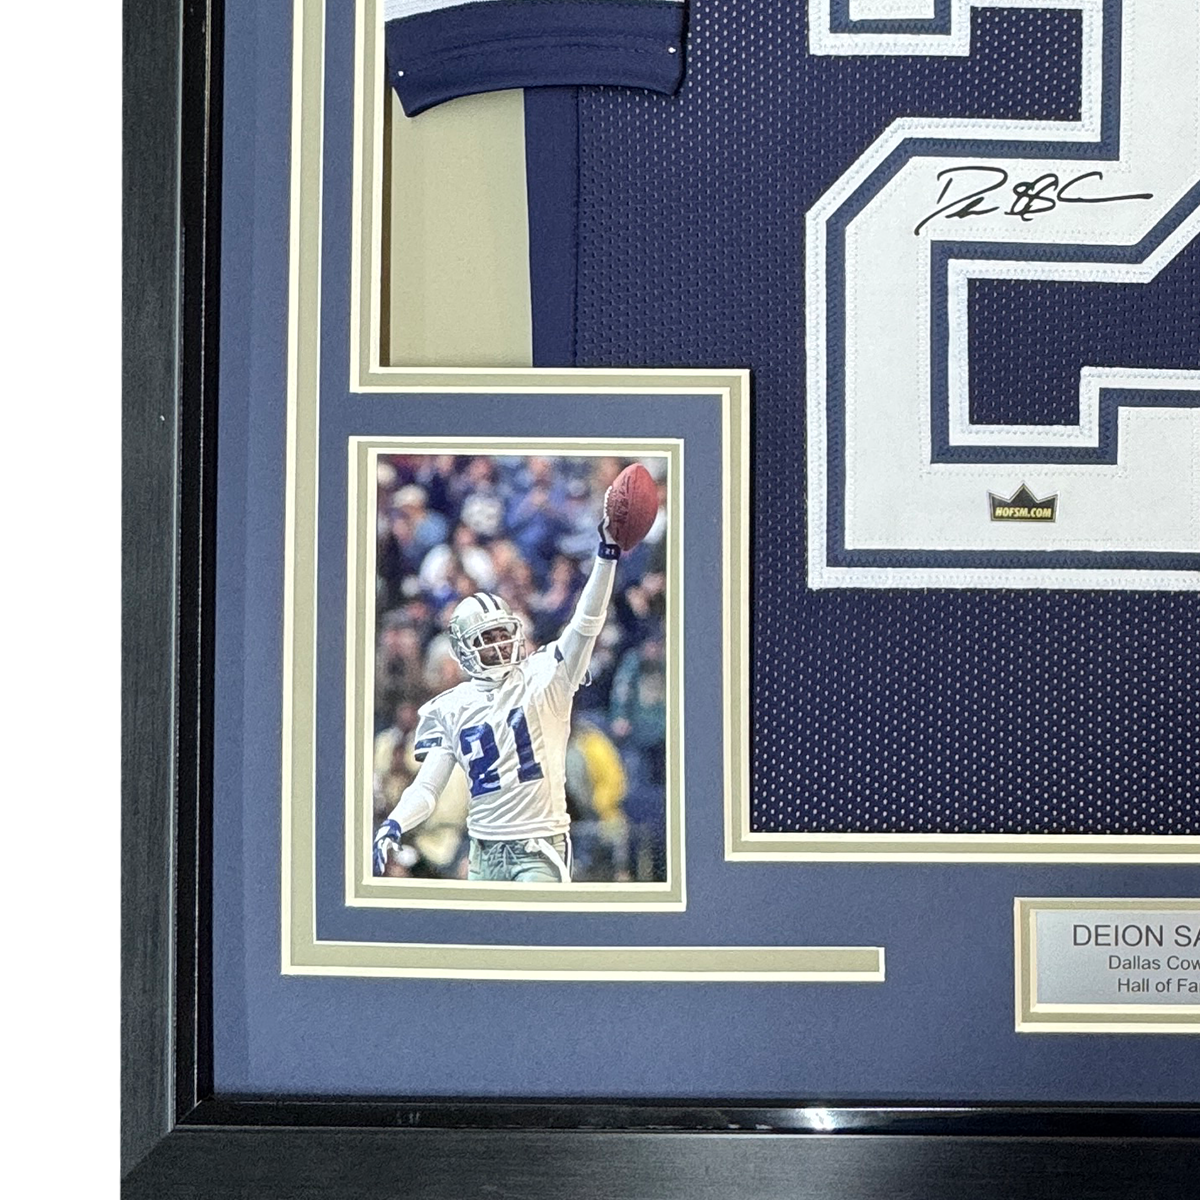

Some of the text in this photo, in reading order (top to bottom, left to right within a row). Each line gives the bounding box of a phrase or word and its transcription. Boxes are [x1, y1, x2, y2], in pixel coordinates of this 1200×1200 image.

[995, 506, 1053, 519] HOFSM.COM
[459, 705, 545, 799] 21
[1073, 924, 1164, 947] DEION
[1108, 955, 1161, 971] Dallas
[1117, 978, 1150, 993] Hall
[1155, 978, 1172, 993] of
